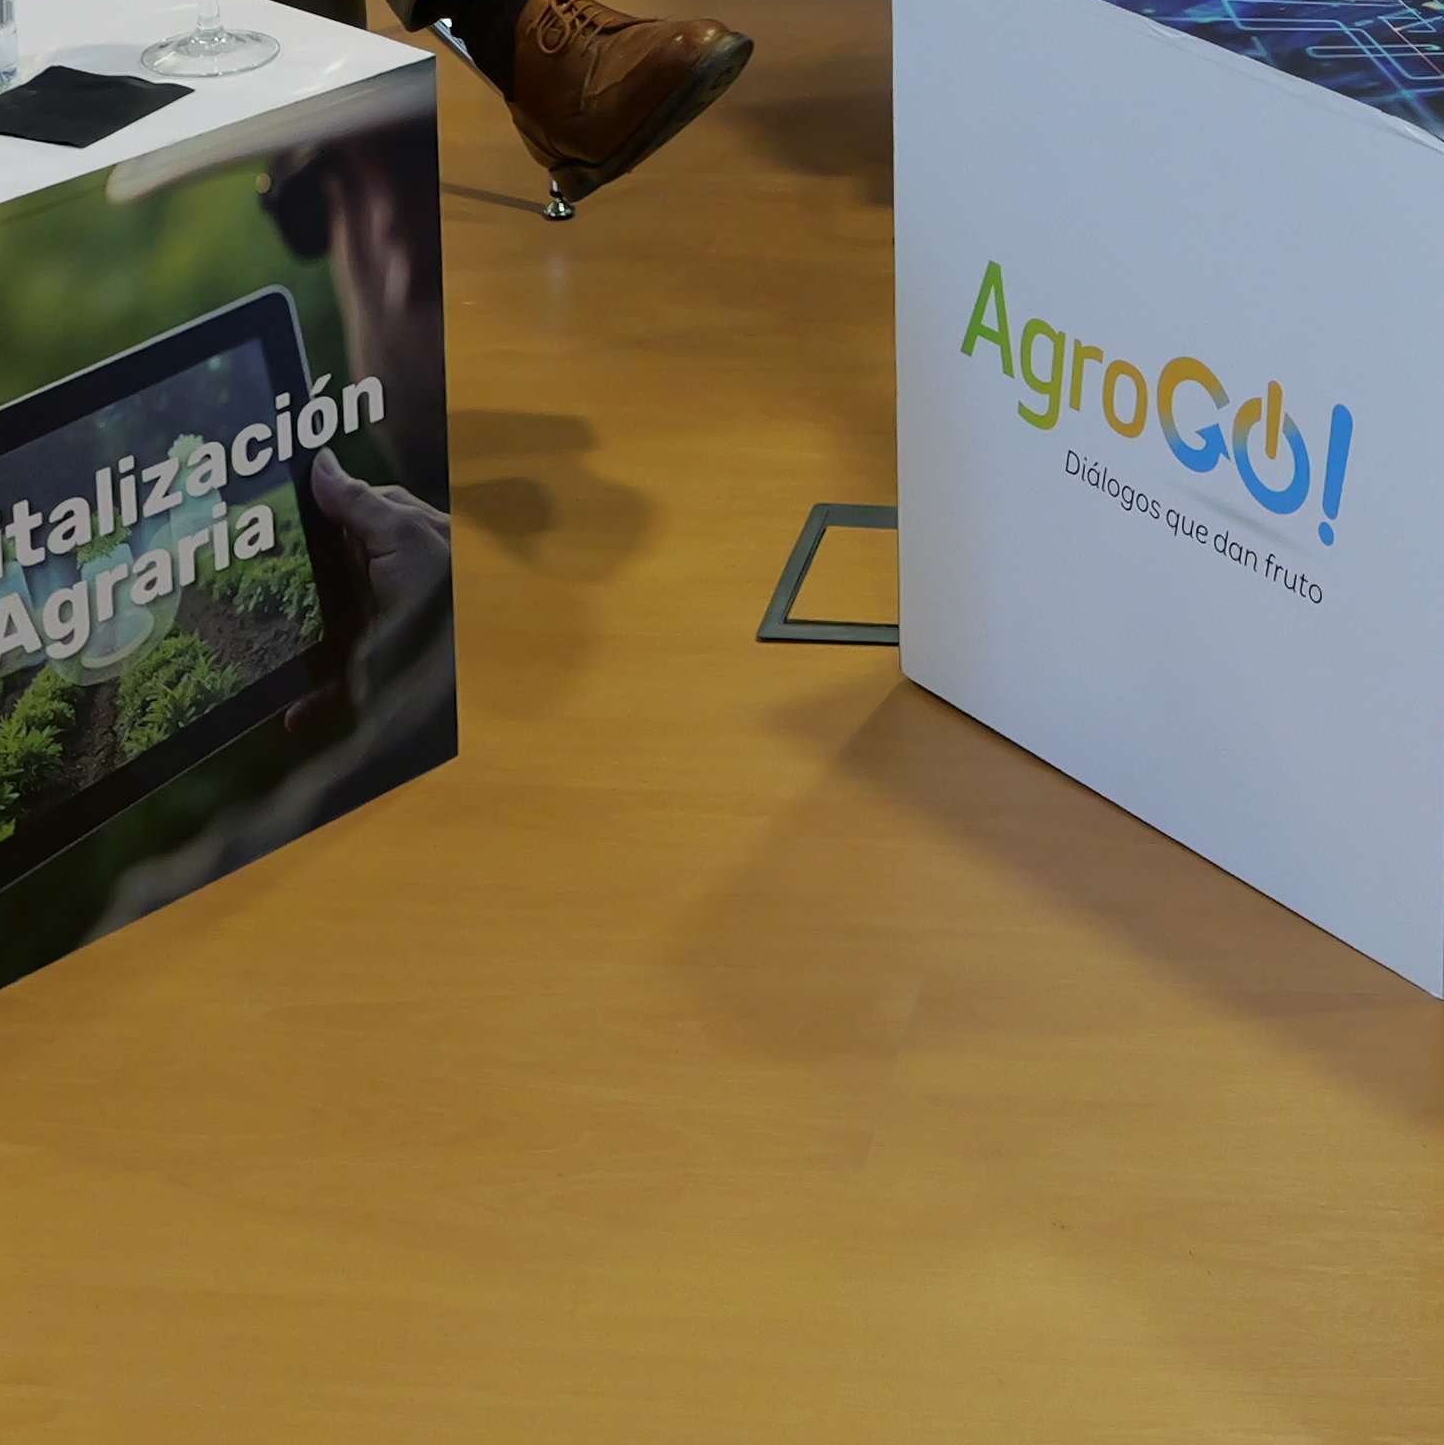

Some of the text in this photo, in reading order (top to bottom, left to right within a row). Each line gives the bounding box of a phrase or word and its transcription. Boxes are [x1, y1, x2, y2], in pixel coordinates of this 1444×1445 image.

[1065, 449, 1323, 605] Diálogos que dan fruto
